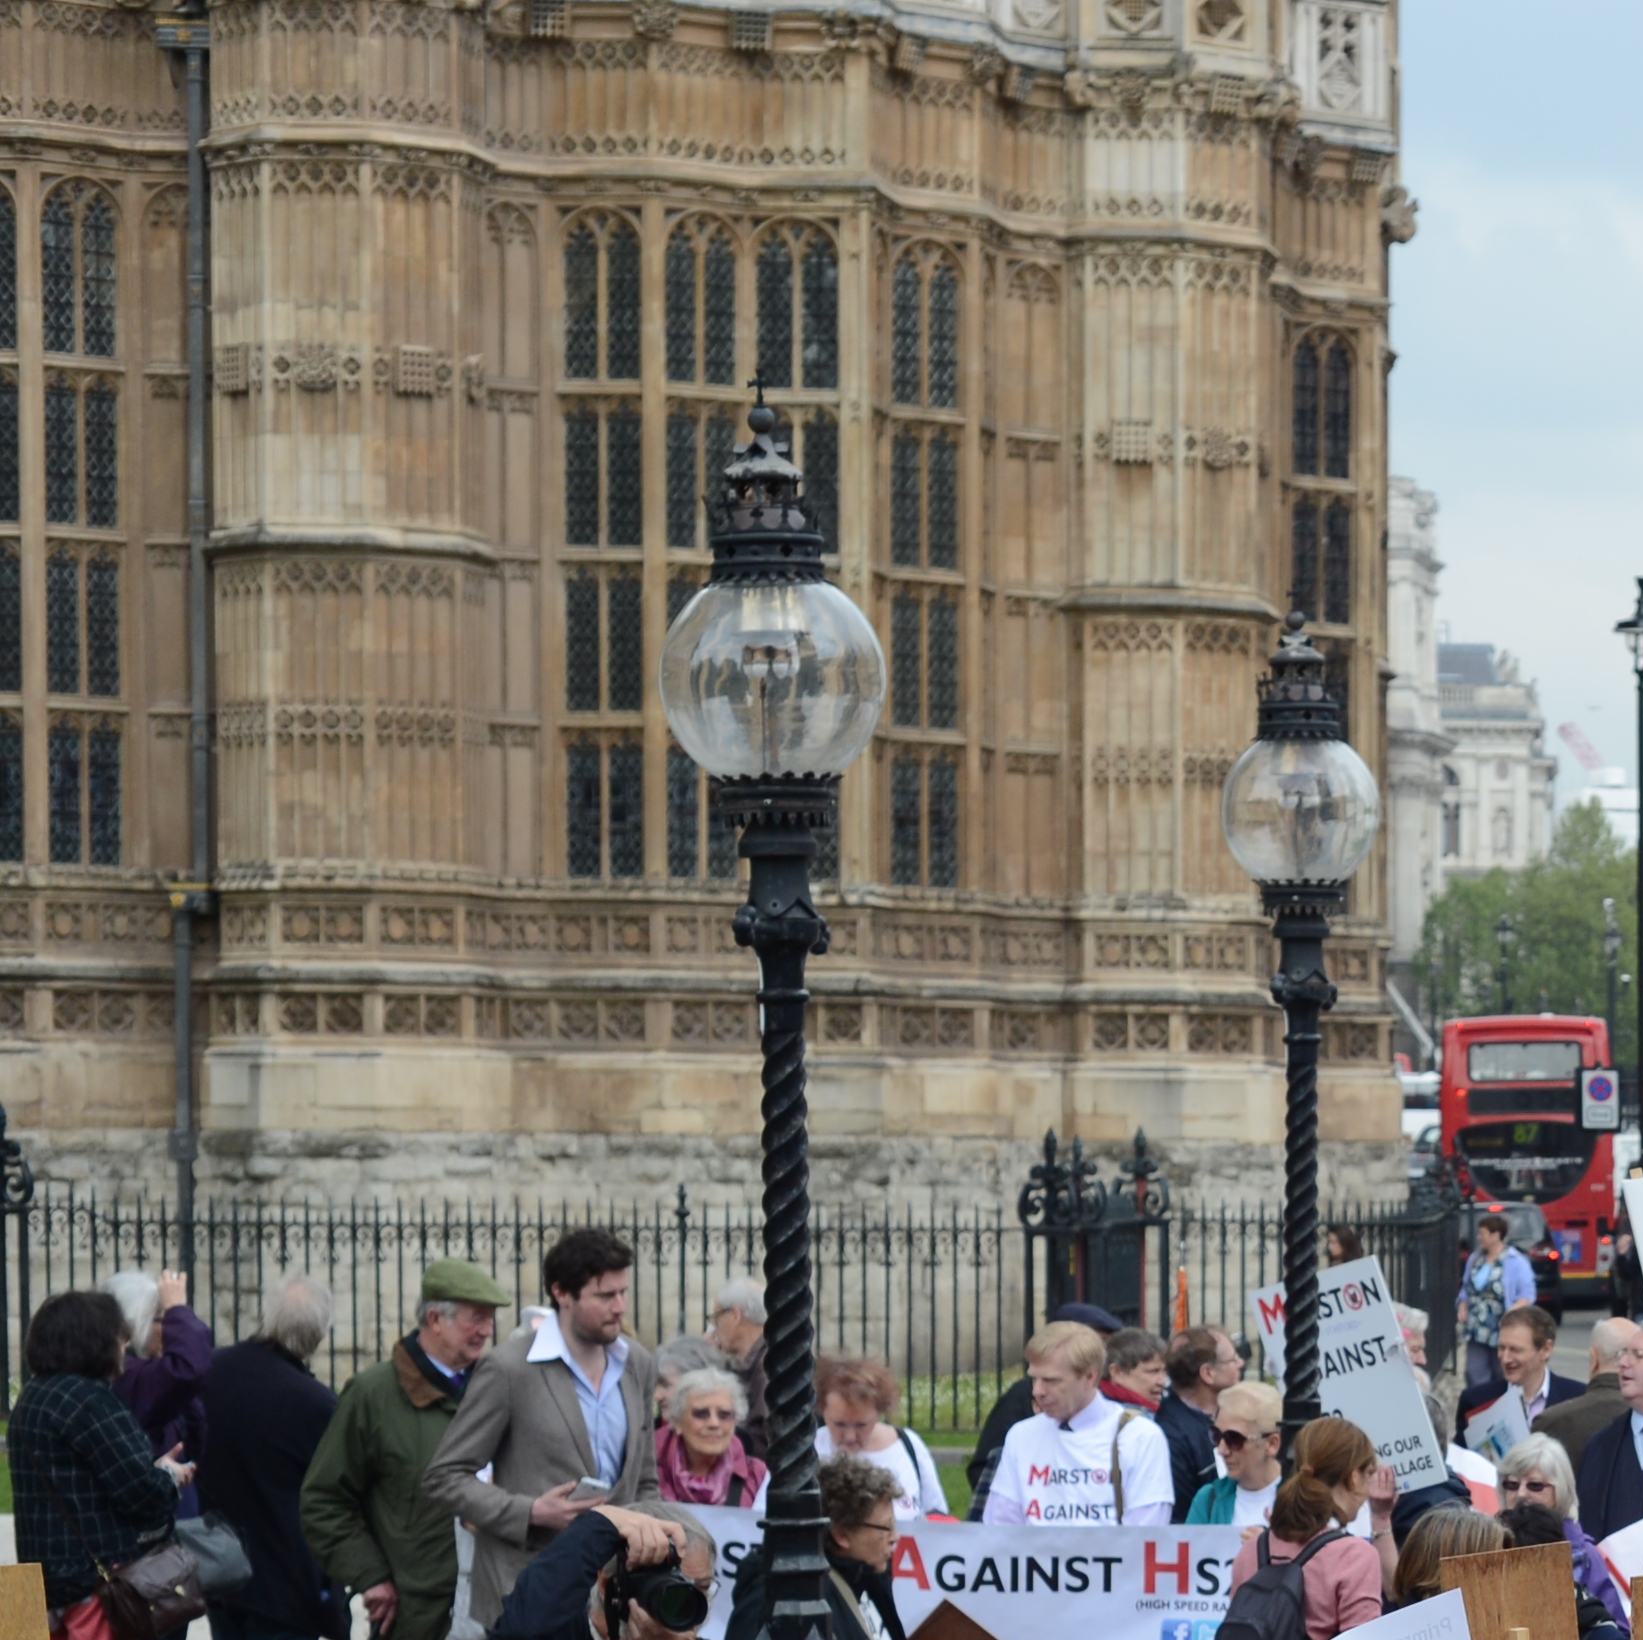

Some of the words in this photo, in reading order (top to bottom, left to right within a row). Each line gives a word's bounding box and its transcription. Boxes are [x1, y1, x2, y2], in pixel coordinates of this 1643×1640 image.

[1394, 1434, 1423, 1456] OUR
[1390, 1454, 1434, 1478] ILLAGE
[1026, 1498, 1114, 1521] AGAINST
[892, 1535, 1123, 1594] AGAINST
[1173, 1600, 1208, 1612] SPEED
